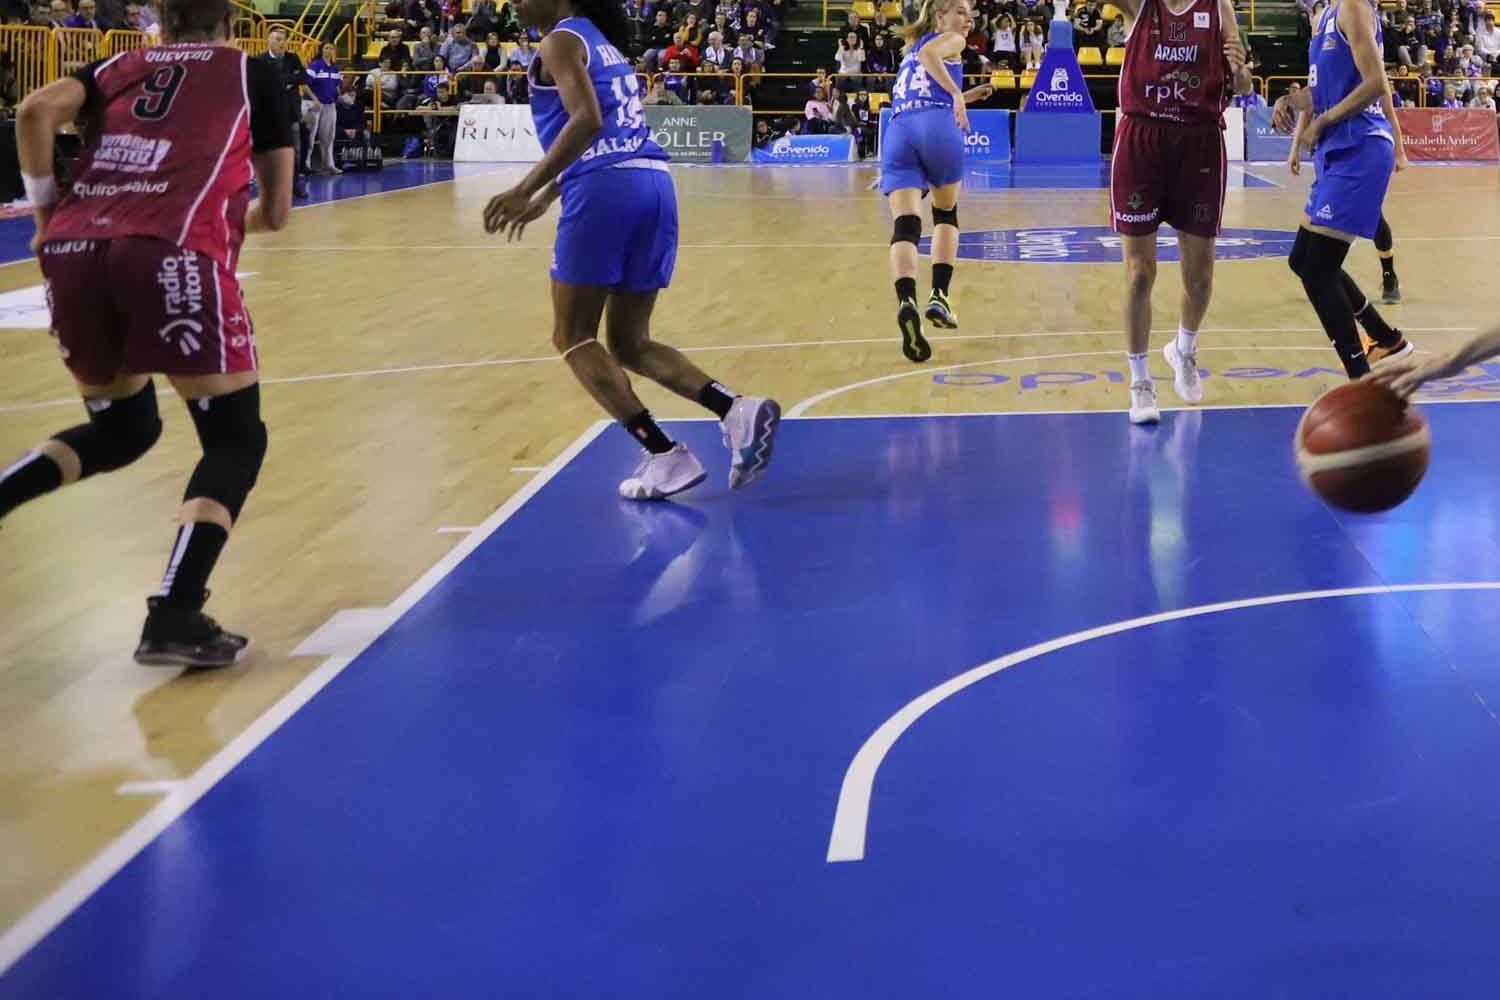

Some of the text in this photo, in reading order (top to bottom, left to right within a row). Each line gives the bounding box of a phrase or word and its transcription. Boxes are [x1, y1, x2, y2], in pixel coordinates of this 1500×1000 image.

[1154, 43, 1199, 62] ARASKI
[131, 62, 187, 120] 9
[1145, 82, 1185, 104] rpk
[663, 117, 697, 127] ANNE
[655, 127, 726, 148] ÖLLER
[1449, 135, 1478, 146] Arden
[158, 256, 182, 315] radio
